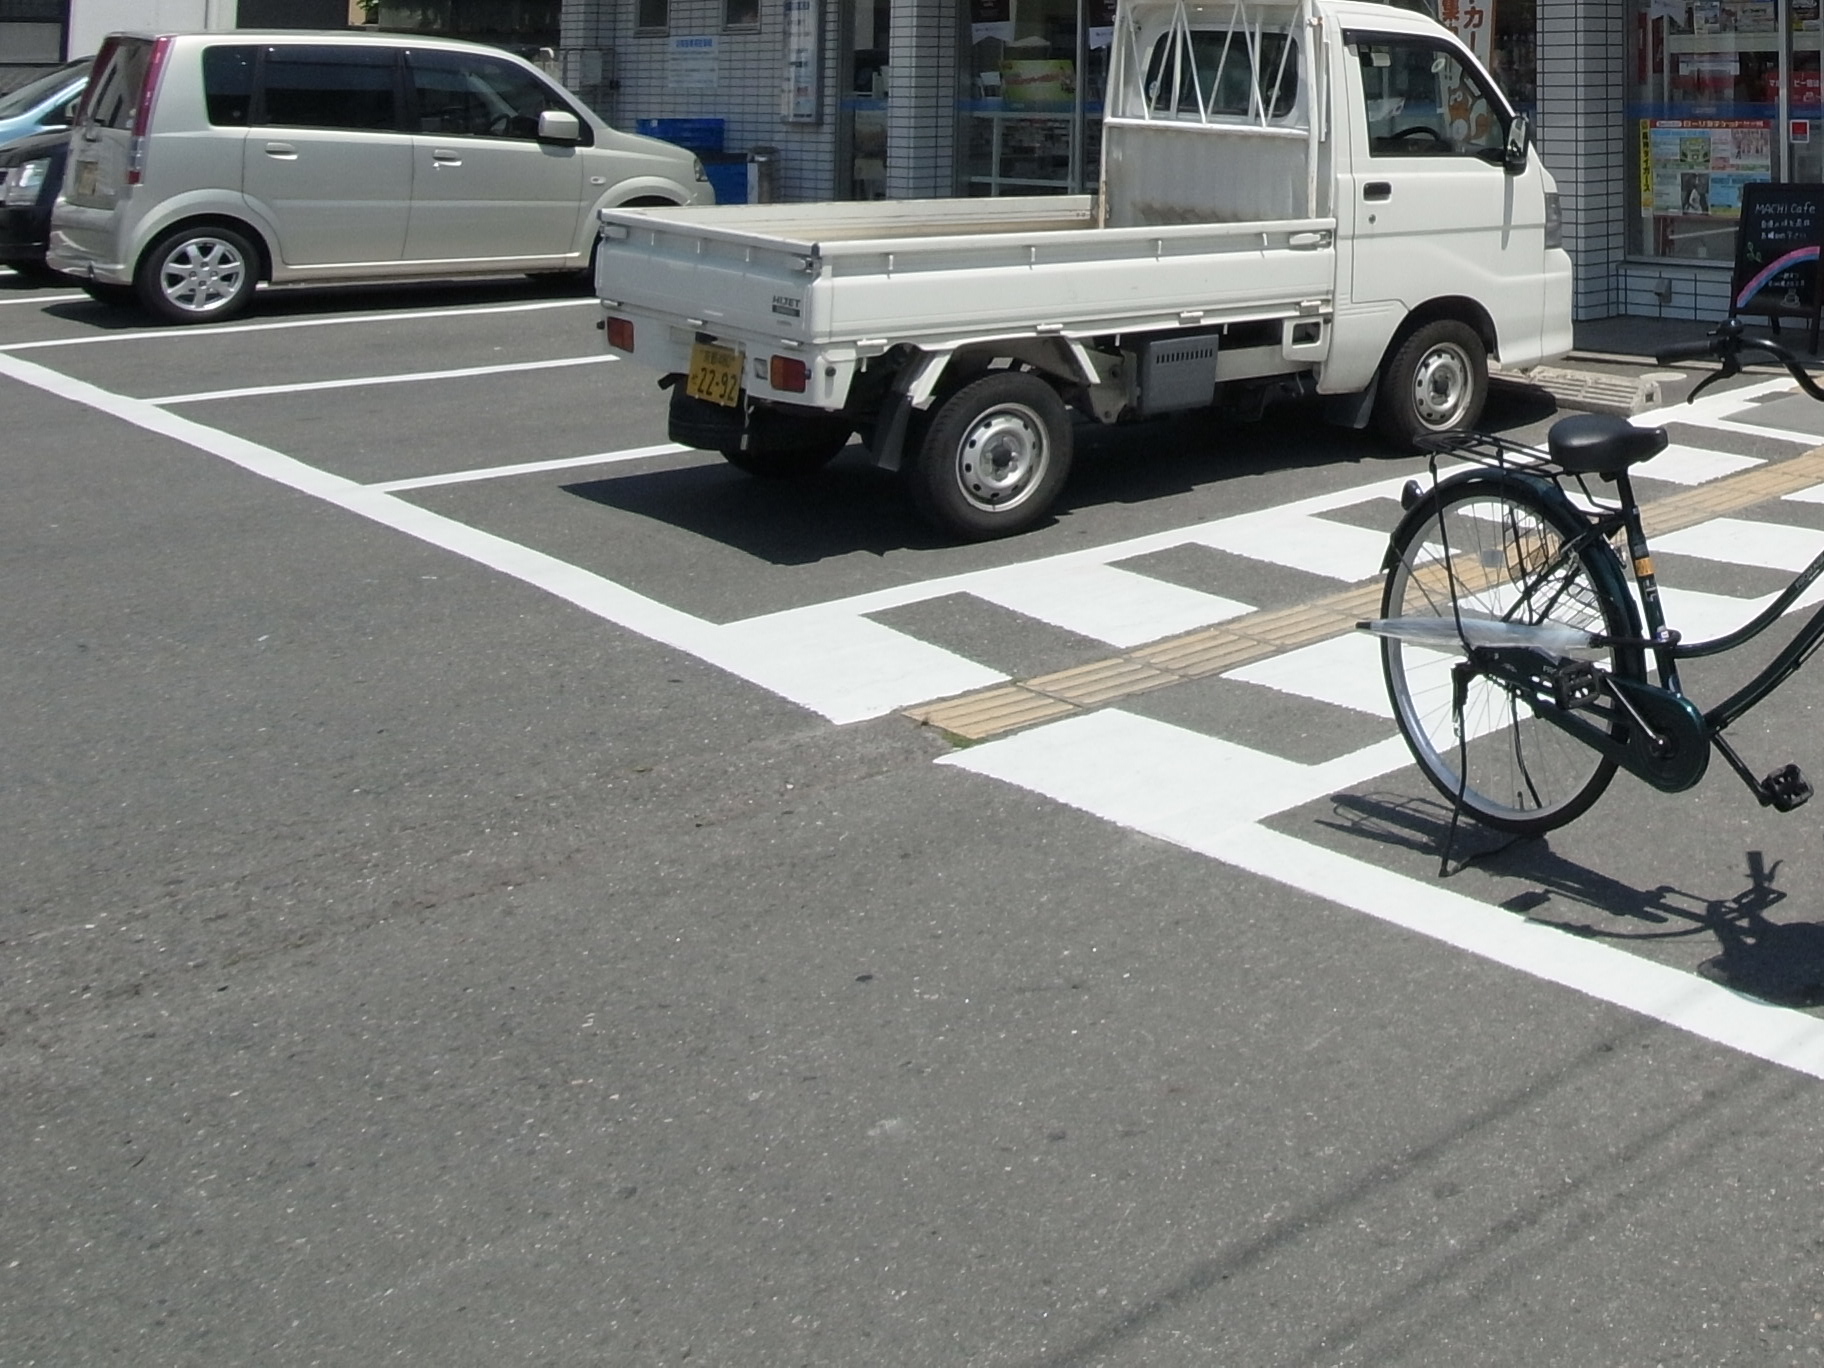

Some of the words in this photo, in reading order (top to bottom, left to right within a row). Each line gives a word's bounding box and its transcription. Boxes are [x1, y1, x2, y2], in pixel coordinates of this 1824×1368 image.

[1755, 203, 1788, 214] MACHI
[1790, 201, 1816, 214] Cafe
[772, 295, 800, 308] HIJET
